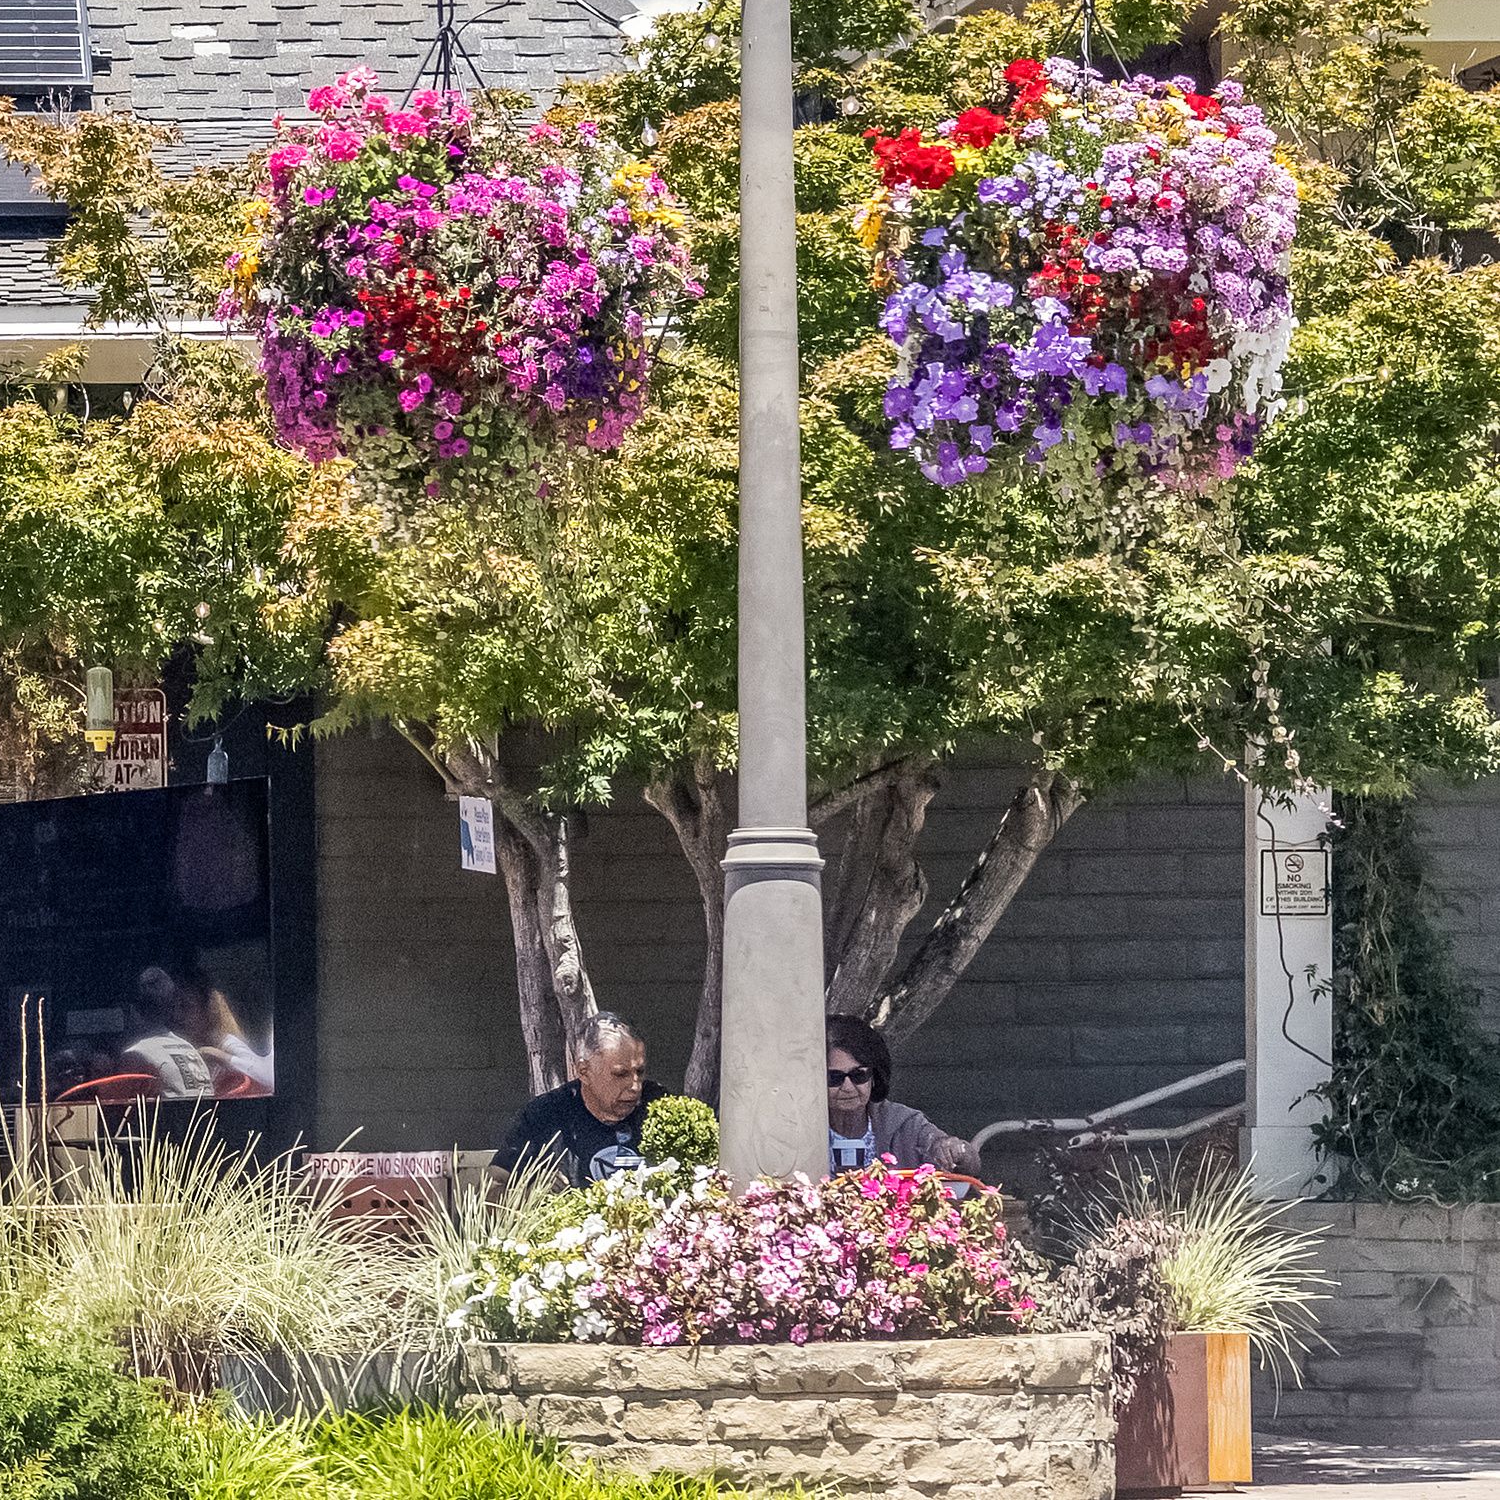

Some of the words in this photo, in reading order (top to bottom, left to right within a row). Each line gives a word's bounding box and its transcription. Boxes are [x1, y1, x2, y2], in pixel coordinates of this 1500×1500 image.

[114, 701, 160, 723] TION
[115, 764, 132, 784] AT
[1287, 874, 1302, 882] NO
[313, 1157, 375, 1175] PROPANE
[377, 1157, 391, 1175] NO
[394, 1156, 442, 1175] SMOKING
